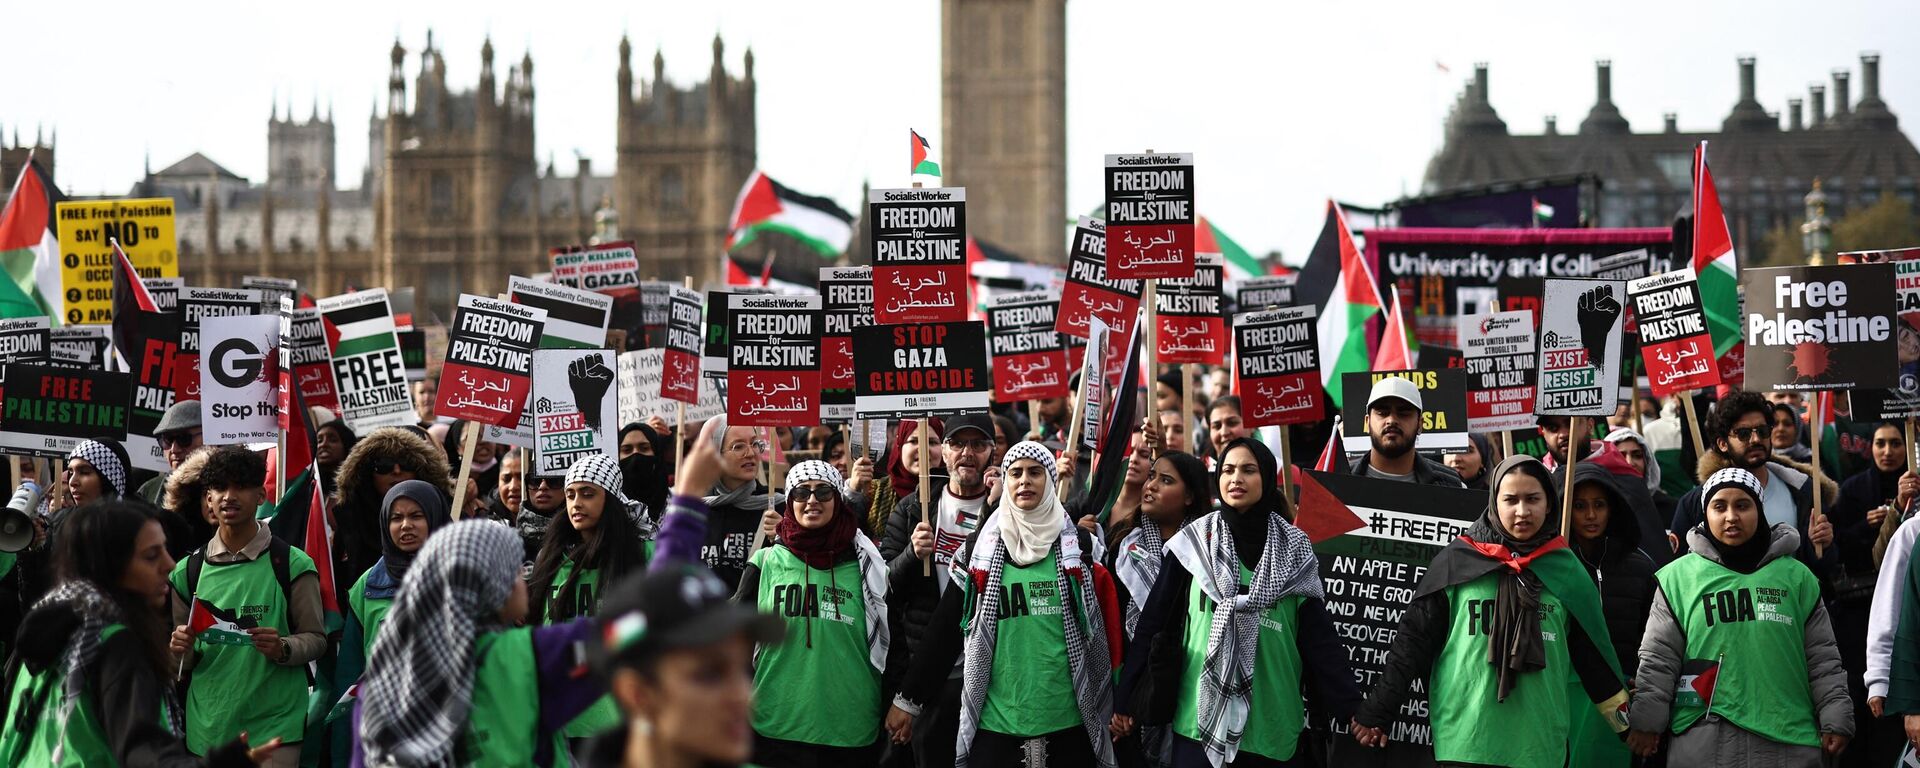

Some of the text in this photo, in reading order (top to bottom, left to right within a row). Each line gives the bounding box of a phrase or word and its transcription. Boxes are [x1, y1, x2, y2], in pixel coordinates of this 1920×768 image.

[1113, 170, 1184, 191] FREEDOM
[1144, 190, 1156, 200] for
[61, 205, 172, 220] FREE Free Palestine
[880, 206, 955, 229] FREEDOM
[1110, 200, 1189, 221] PALESTINE
[76, 221, 159, 247] SAY NO TO
[912, 228, 925, 238] for
[1124, 229, 1175, 249] الحرية
[555, 251, 632, 265] STOP KILLING
[877, 239, 961, 261] PALESTINE
[1118, 249, 1183, 269] لفلسطين
[580, 261, 636, 273] CHILDREN
[1388, 252, 1548, 282] University and
[584, 272, 635, 288] GAZA
[892, 270, 946, 291] الحرية
[1180, 286, 1190, 294] for
[513, 281, 608, 308] Palestine Solidarity Campaign
[886, 291, 955, 312] لفلسطين
[1078, 290, 1124, 313] الحرية
[1241, 288, 1292, 305] FREEDOM
[1636, 285, 1694, 315] FREEDOM
[1775, 275, 1847, 309] Free
[859, 304, 870, 313] for
[1155, 294, 1219, 314] PALESTINE
[1662, 309, 1673, 319] for
[737, 314, 811, 335] FREEDOM
[993, 305, 1054, 328] FREEDOM
[1489, 317, 1520, 325] Socialist
[461, 312, 534, 344] FREEDOM
[893, 325, 947, 346] STOP
[1163, 320, 1208, 338] الحرية
[1243, 322, 1309, 347] FREEDOM
[1486, 324, 1509, 332] Party
[1640, 313, 1704, 343] PALESTINE
[1749, 309, 1890, 346] Palestine
[488, 335, 500, 346] for
[769, 335, 781, 345] for
[993, 331, 1060, 353] PALESTINE
[1158, 338, 1215, 354] لفلسطين
[1272, 344, 1284, 354] for
[1468, 338, 1485, 347] MASS
[1486, 337, 1504, 346] UNITED
[1484, 346, 1509, 354] STRUGGLE
[451, 340, 530, 372] PALESTINE
[733, 345, 815, 366] PALESTINE
[894, 347, 948, 369] GAZA
[1242, 349, 1315, 375] PALESTINE
[1544, 350, 1587, 368] EXIST.
[1656, 341, 1699, 365] الحرية
[333, 349, 404, 393] FREE
[1007, 356, 1050, 375] الحرية
[1466, 358, 1493, 374] STOP
[1496, 356, 1512, 372] THE
[1513, 354, 1534, 370] WAR
[1658, 358, 1710, 385] لفلسطين
[41, 375, 93, 400] FREE
[459, 370, 510, 392] الحرية
[746, 375, 800, 396] الحرية
[869, 368, 974, 392] GENOCIDE
[1004, 372, 1059, 393] لفلسطين
[1257, 378, 1304, 398] الحرية
[1481, 371, 1525, 388] ON GAZA!
[1544, 370, 1594, 388] RESIST.
[340, 384, 408, 410] PALESTINE
[447, 391, 513, 413] لفلسطين
[904, 397, 918, 407] FOA
[1474, 387, 1532, 403] FOR A SOCIALIST
[1544, 389, 1601, 408] RETURN.
[5, 397, 124, 428] PALESTINE
[212, 401, 279, 420] Stop the
[740, 396, 807, 415] لفلسطين
[1253, 395, 1313, 418] لفلسطين
[1491, 401, 1523, 415] INTIFADA
[539, 415, 584, 432] EXIST.
[44, 438, 57, 448] FOA
[541, 433, 593, 451] RESIST.
[1331, 555, 1408, 582] AN APPLE
[1029, 581, 1054, 589] FRIENDS
[1029, 589, 1054, 597] AL-AQSA
[1324, 577, 1380, 600] TO THE
[1756, 587, 1780, 597] FRIENDS
[774, 583, 818, 617] FOA
[1030, 597, 1049, 606] PEACE
[1325, 600, 1356, 617] AND
[1702, 587, 1756, 627] FOA
[1757, 595, 1782, 605] AL-AQSA
[1757, 602, 1777, 612] PEACE
[1031, 607, 1038, 616] IN
[1758, 612, 1793, 626] IN PALESTINE
